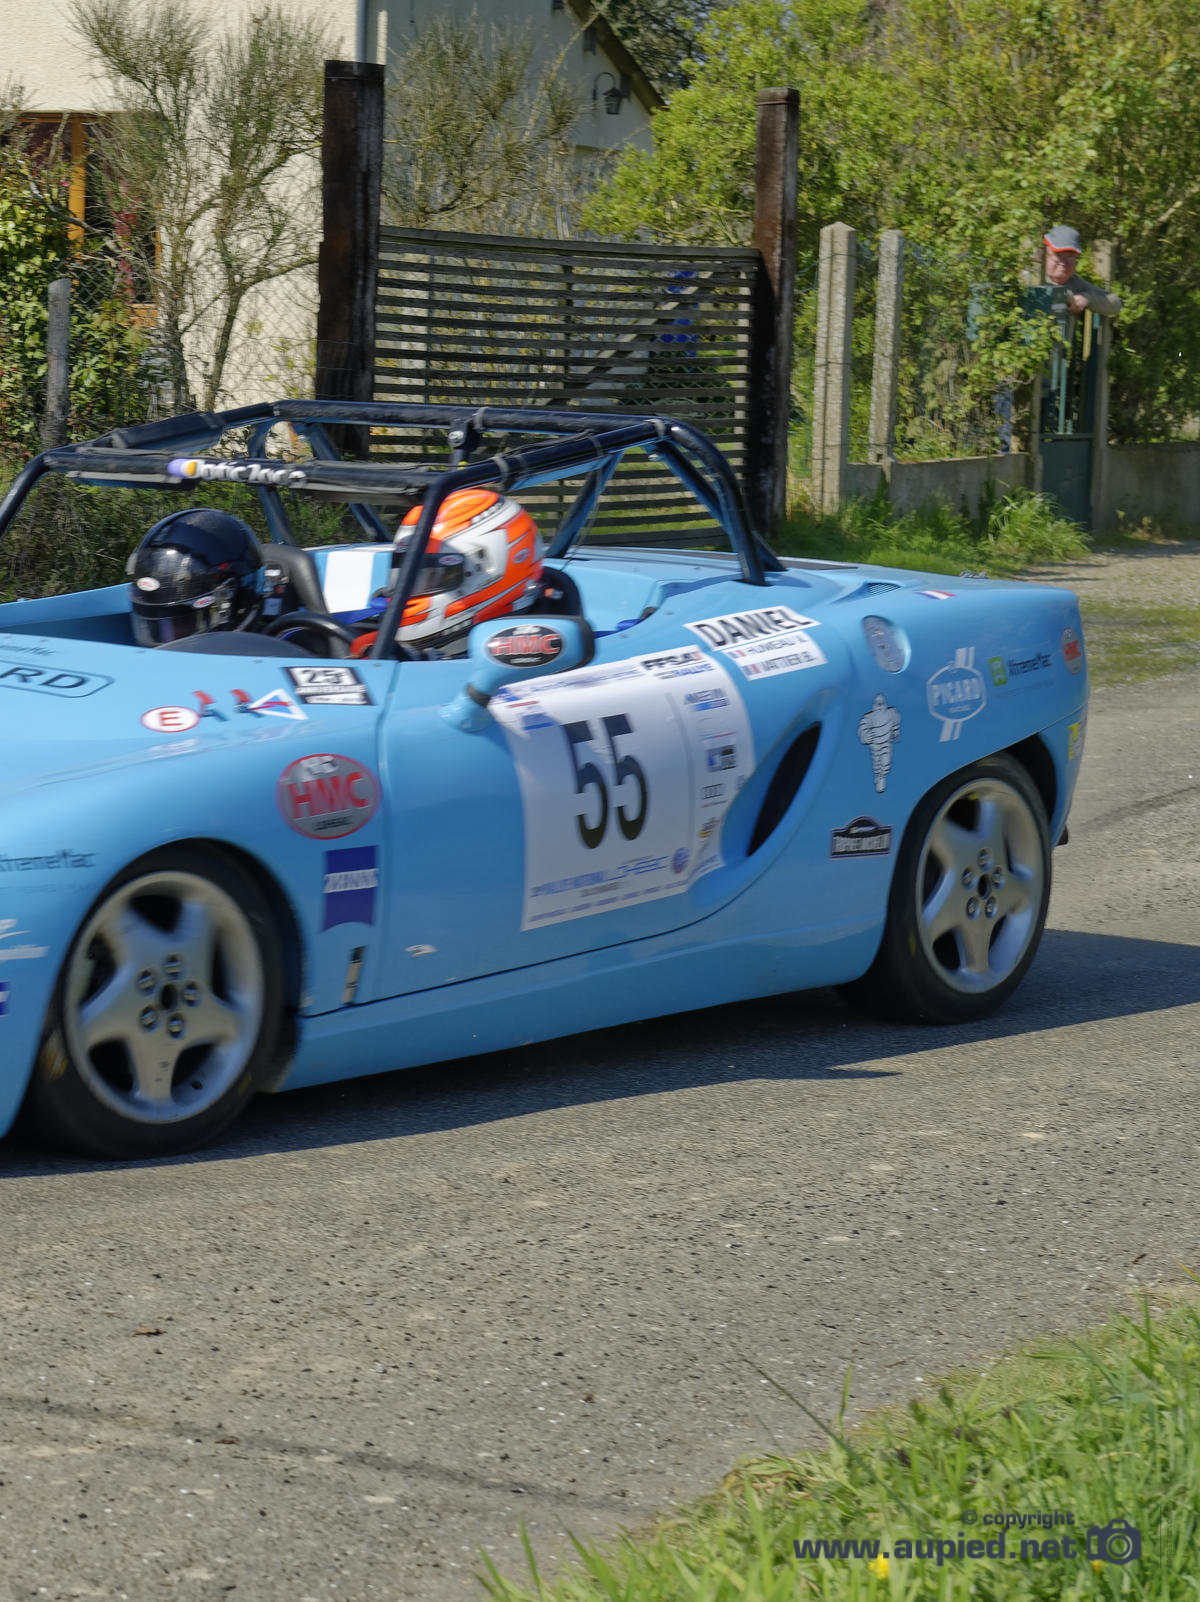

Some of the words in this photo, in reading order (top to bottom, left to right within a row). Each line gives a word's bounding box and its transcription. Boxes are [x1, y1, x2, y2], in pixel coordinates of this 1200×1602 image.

[491, 633, 560, 656] HMC
[697, 608, 811, 647] DANIEL
[159, 711, 183, 727] E
[287, 771, 370, 819] HMC
[560, 713, 648, 849] 55
